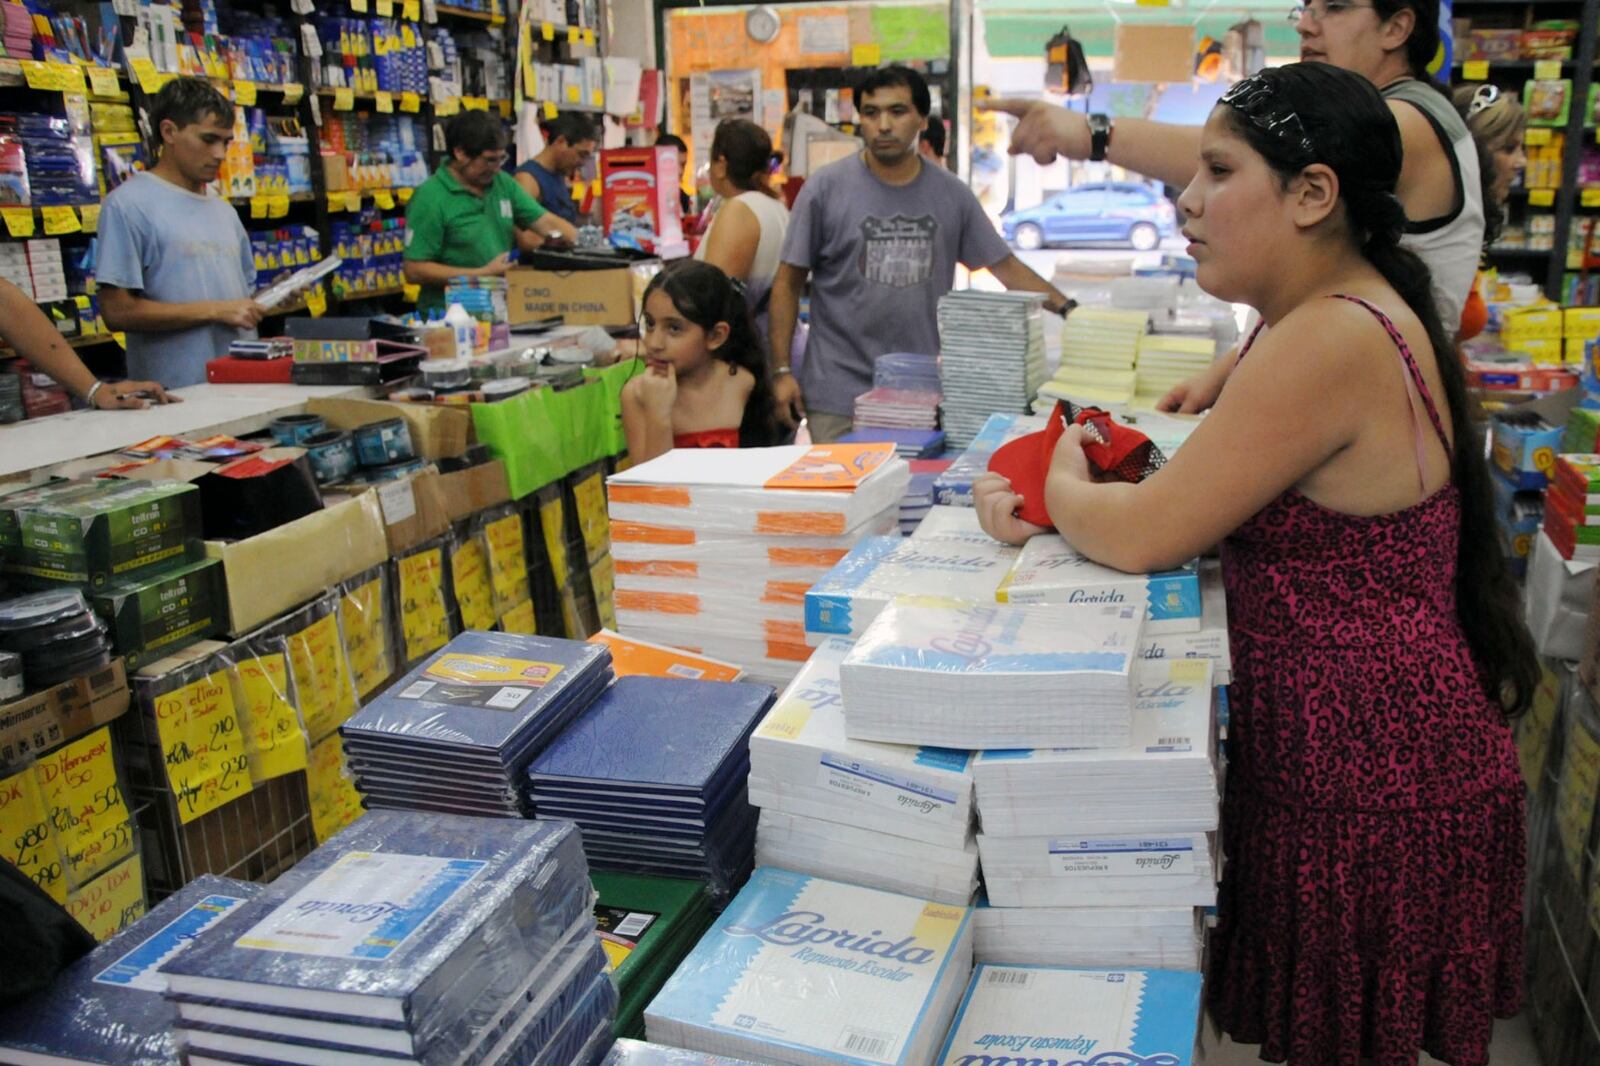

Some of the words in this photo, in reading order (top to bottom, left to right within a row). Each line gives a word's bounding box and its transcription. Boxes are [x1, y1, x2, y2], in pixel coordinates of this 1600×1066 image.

[525, 303, 554, 312] MADE
[558, 303, 569, 312] IN
[897, 794, 941, 814] Laprida
[1136, 854, 1180, 869] Laprida
[722, 911, 936, 966] Laprida
[790, 947, 858, 972] Repuesto
[856, 959, 914, 983] Escolar
[974, 1034, 1030, 1052] Escolar
[1031, 1034, 1098, 1055] Repuesto
